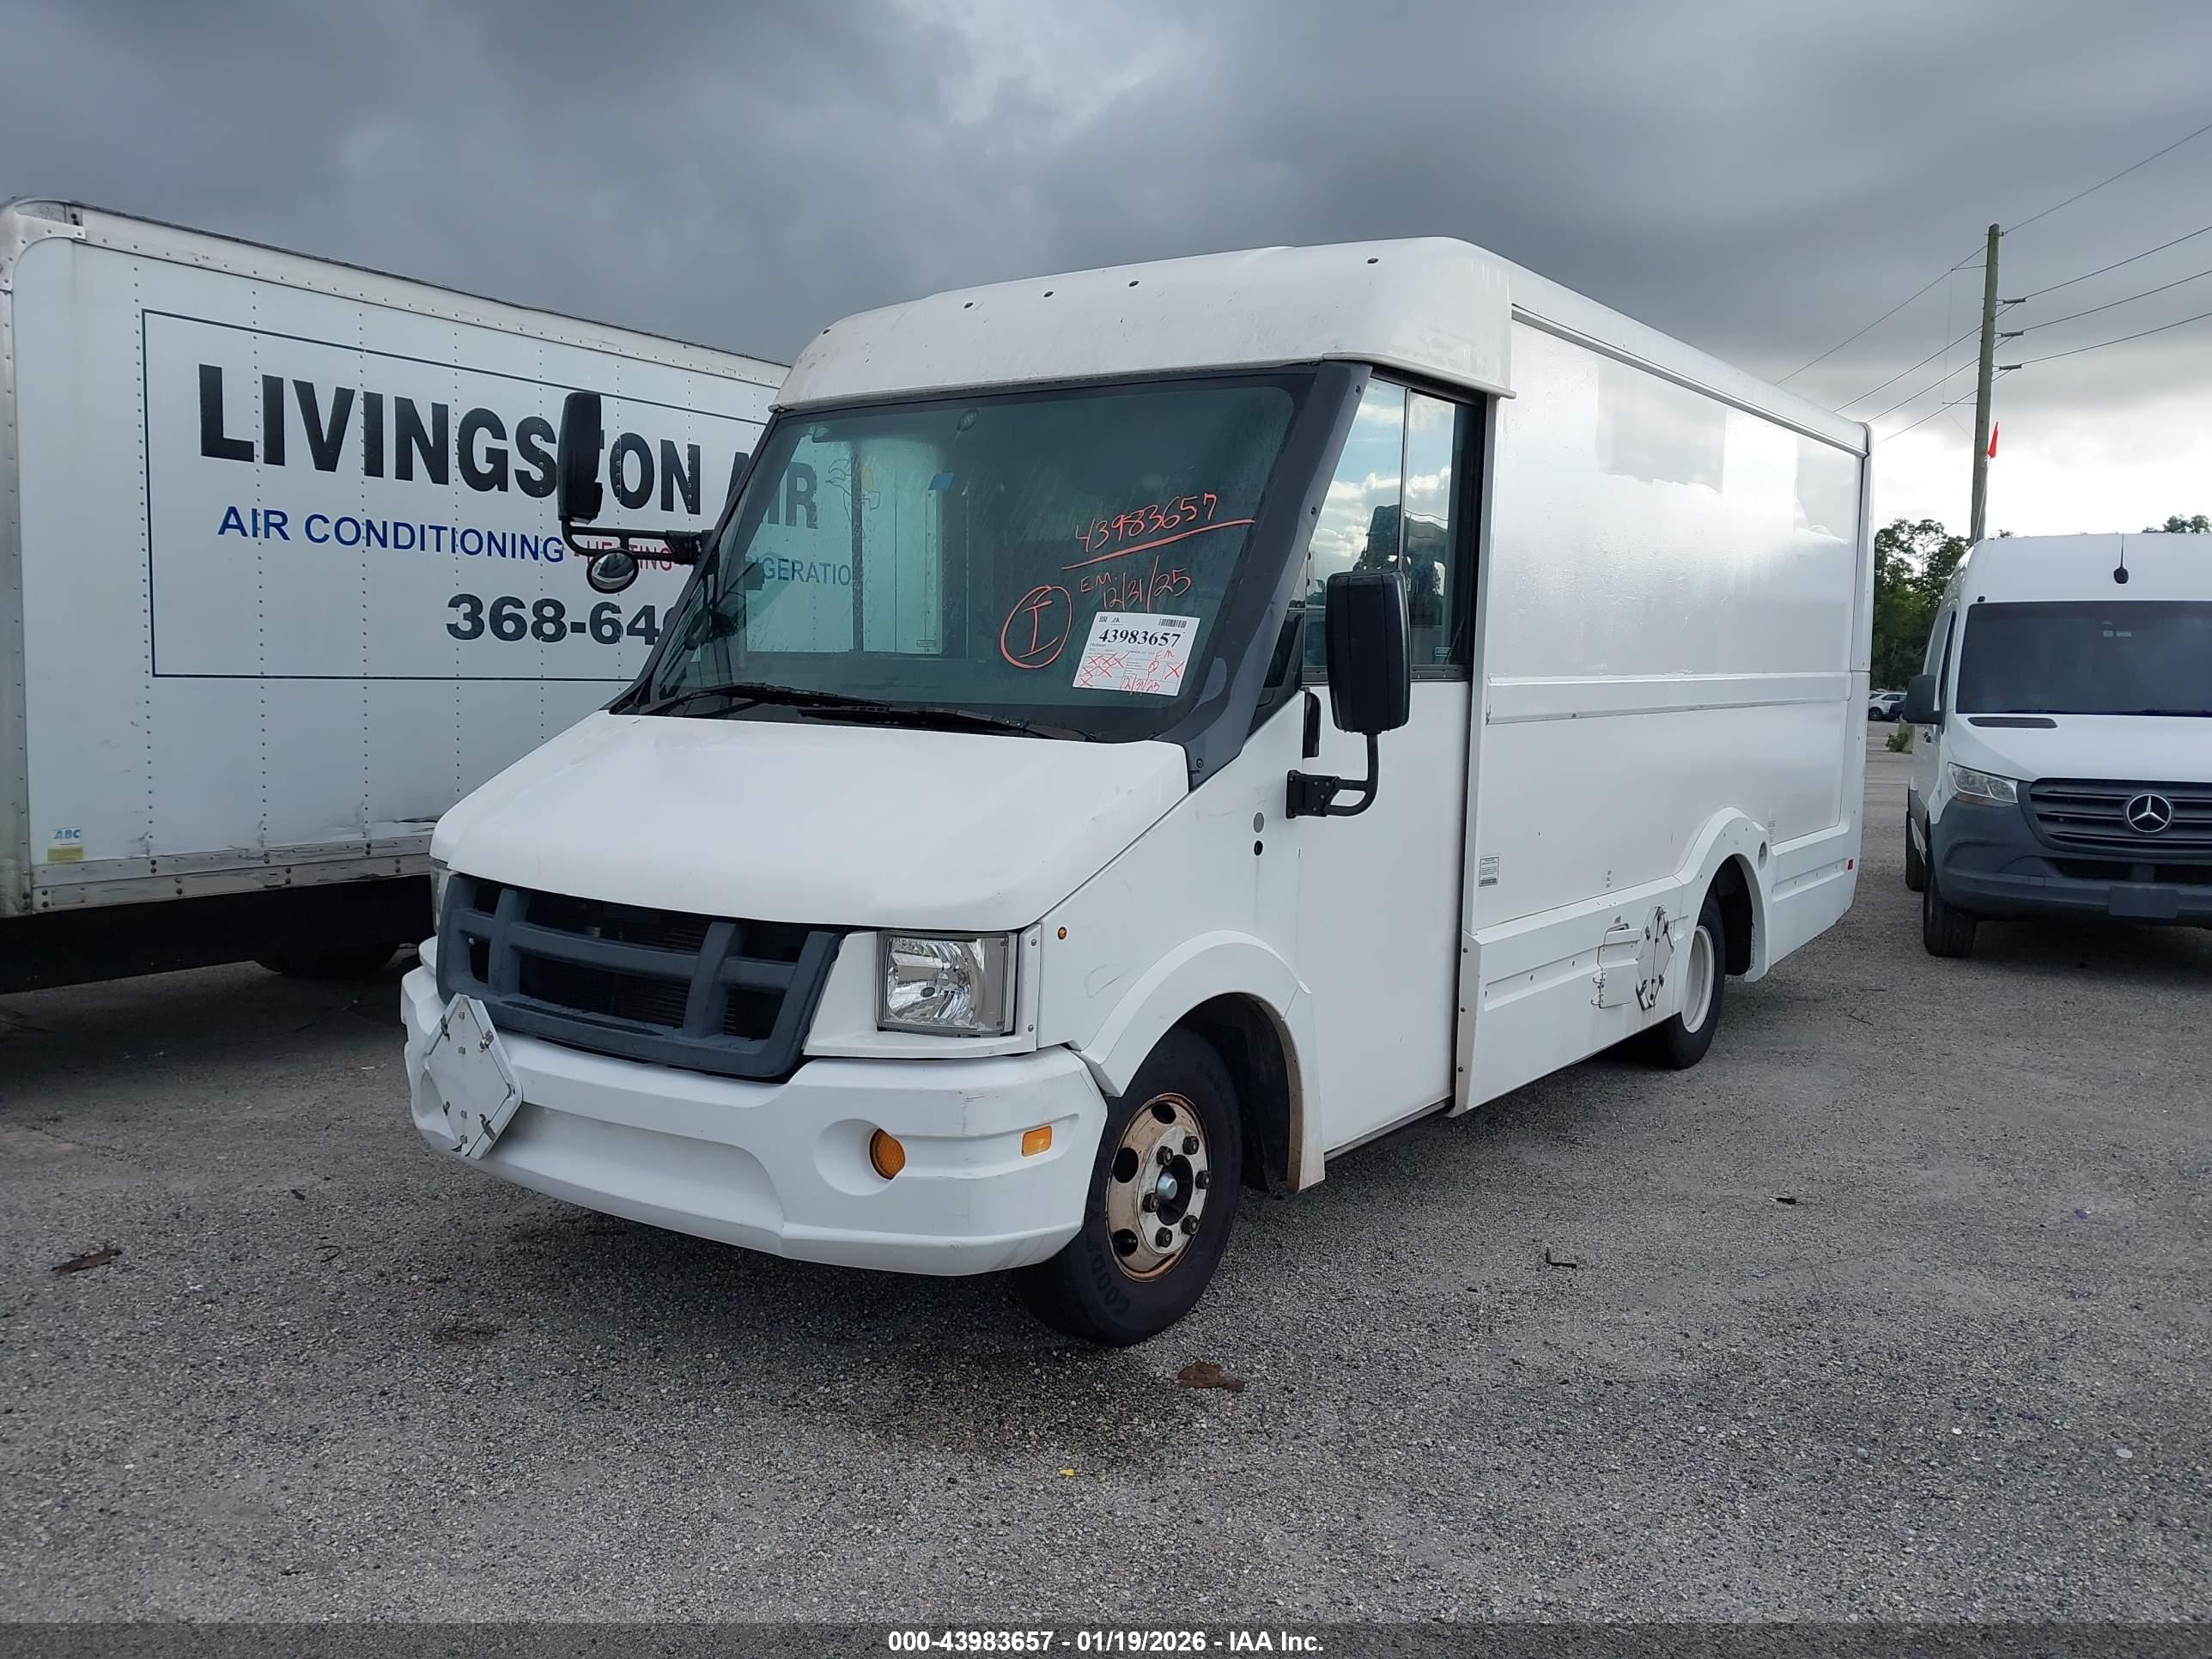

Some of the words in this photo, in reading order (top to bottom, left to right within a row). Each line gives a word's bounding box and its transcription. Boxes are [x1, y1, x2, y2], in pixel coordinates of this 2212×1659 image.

[198, 363, 701, 515] LIVINGSON
[217, 506, 290, 540] AIR
[304, 514, 564, 563] CONDITIONING
[1075, 492, 1217, 552] 43983657
[1103, 556, 1192, 612] 12/31/25
[1098, 629, 1182, 648] 43983657
[54, 829, 81, 839] ABC
